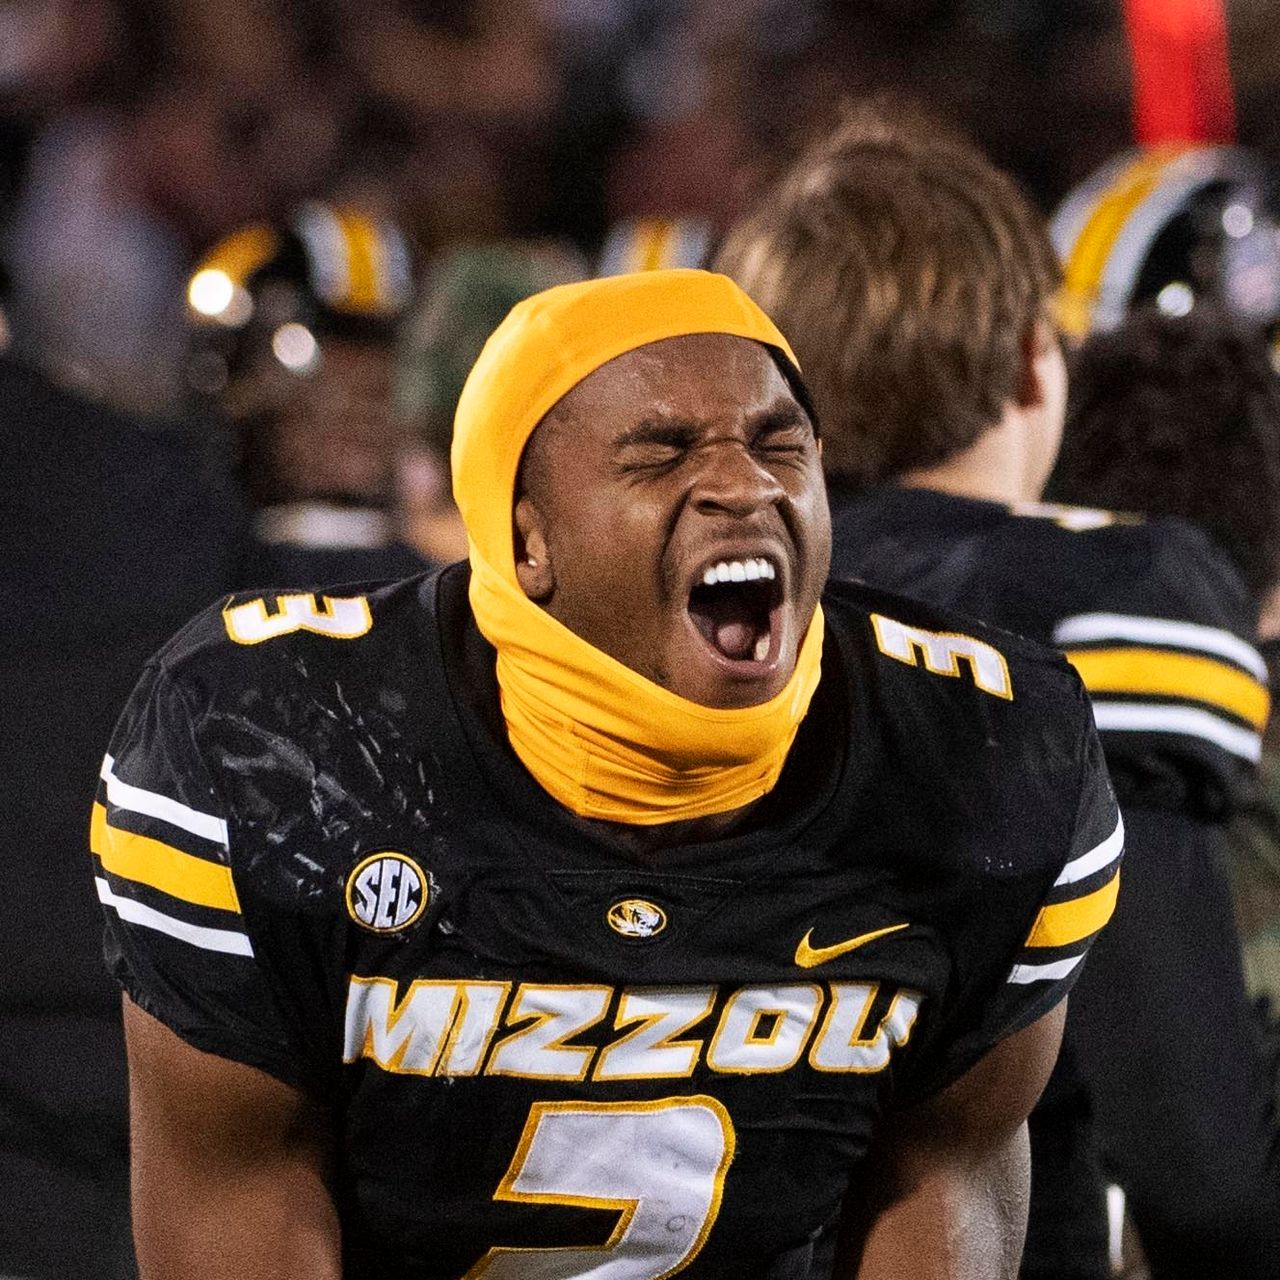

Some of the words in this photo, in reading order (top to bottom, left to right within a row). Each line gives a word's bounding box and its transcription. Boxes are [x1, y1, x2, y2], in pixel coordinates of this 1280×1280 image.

[222, 592, 374, 645] 3
[869, 612, 1014, 701] 3
[353, 857, 421, 929] SEC
[342, 973, 922, 1083] MIZZOU
